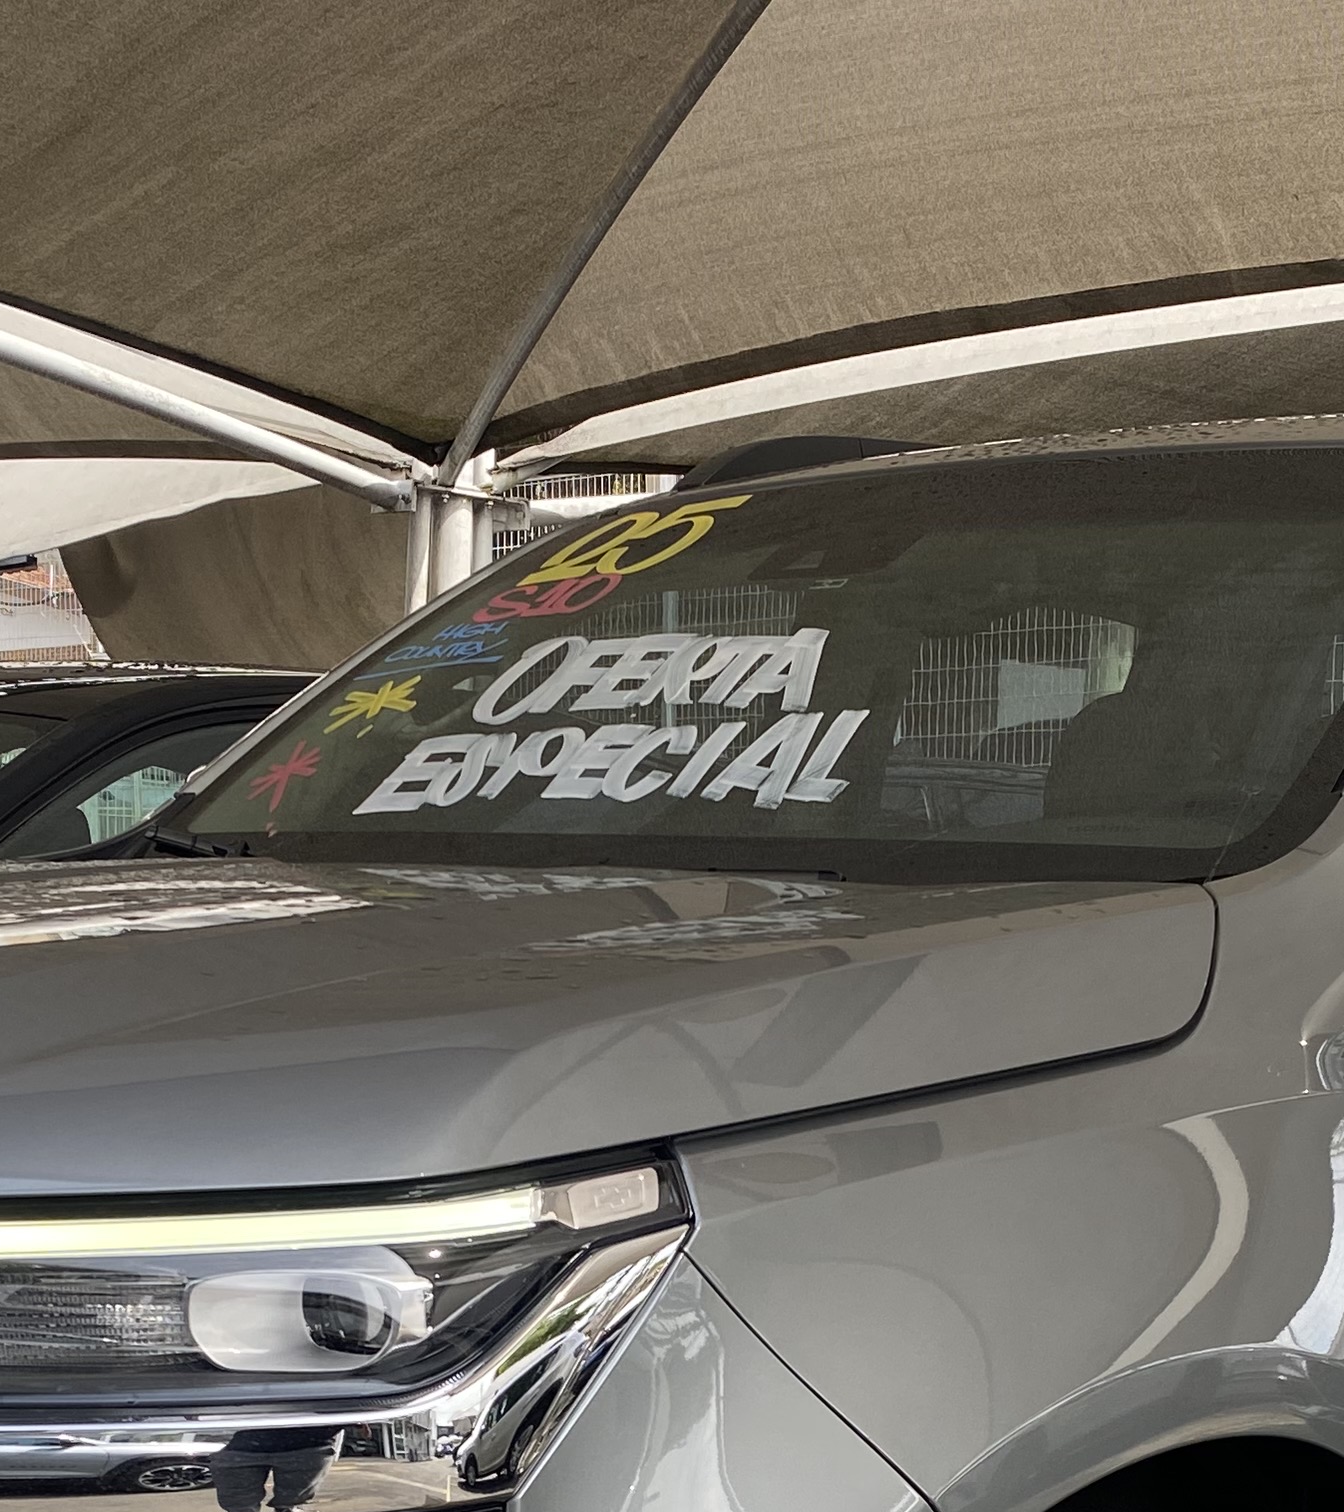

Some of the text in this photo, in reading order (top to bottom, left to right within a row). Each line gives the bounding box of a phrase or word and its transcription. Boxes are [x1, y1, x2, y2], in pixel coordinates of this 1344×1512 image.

[472, 573, 623, 623] S10
[472, 627, 830, 726] OFERTA
[352, 709, 871, 815] ESPECIAL
